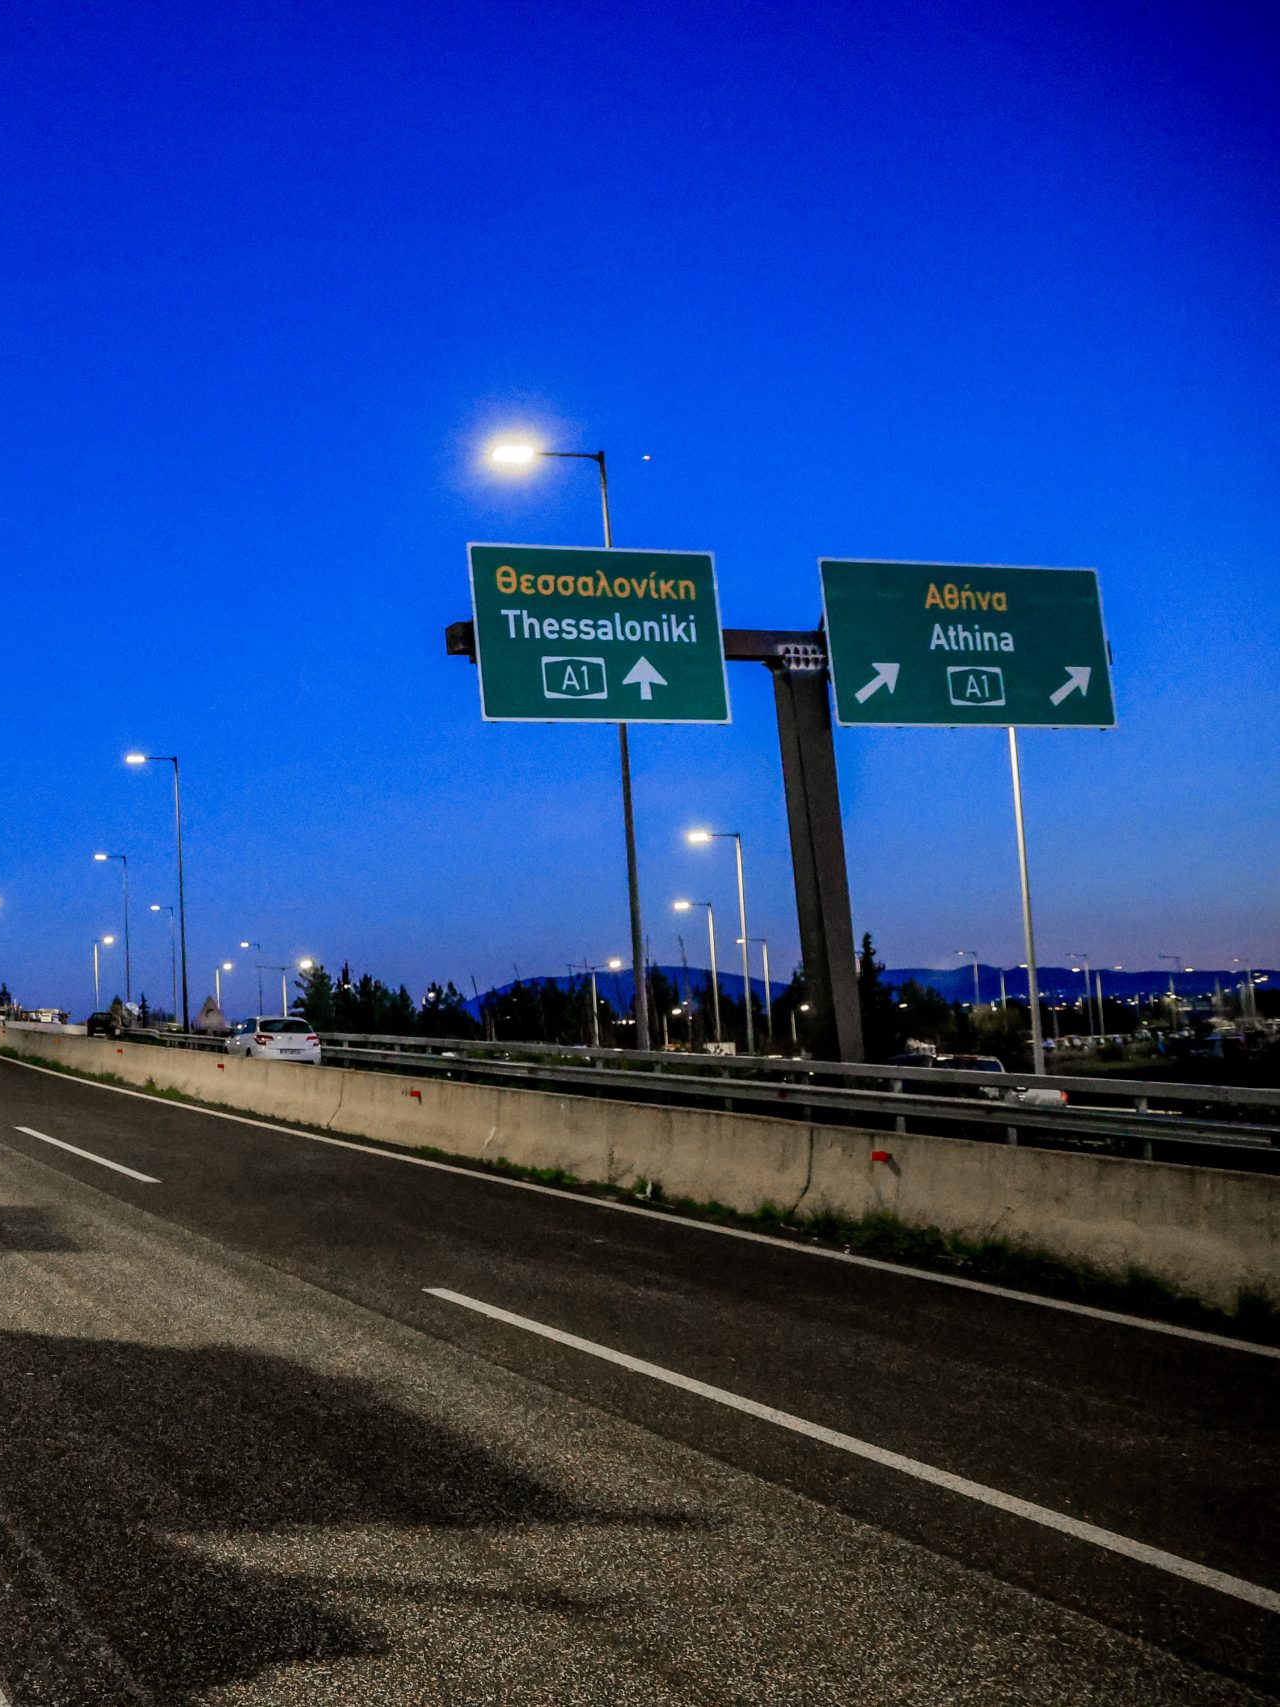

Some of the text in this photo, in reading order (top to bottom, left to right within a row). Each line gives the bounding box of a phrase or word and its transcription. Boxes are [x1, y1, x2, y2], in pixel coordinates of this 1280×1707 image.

[496, 565, 696, 600] Θεσσαλονίκη
[925, 583, 1008, 612] Αθήνα
[500, 609, 697, 643] Thessaloniki
[930, 623, 1015, 652] Athina
[562, 665, 589, 690] A1
[965, 674, 989, 697] A1
